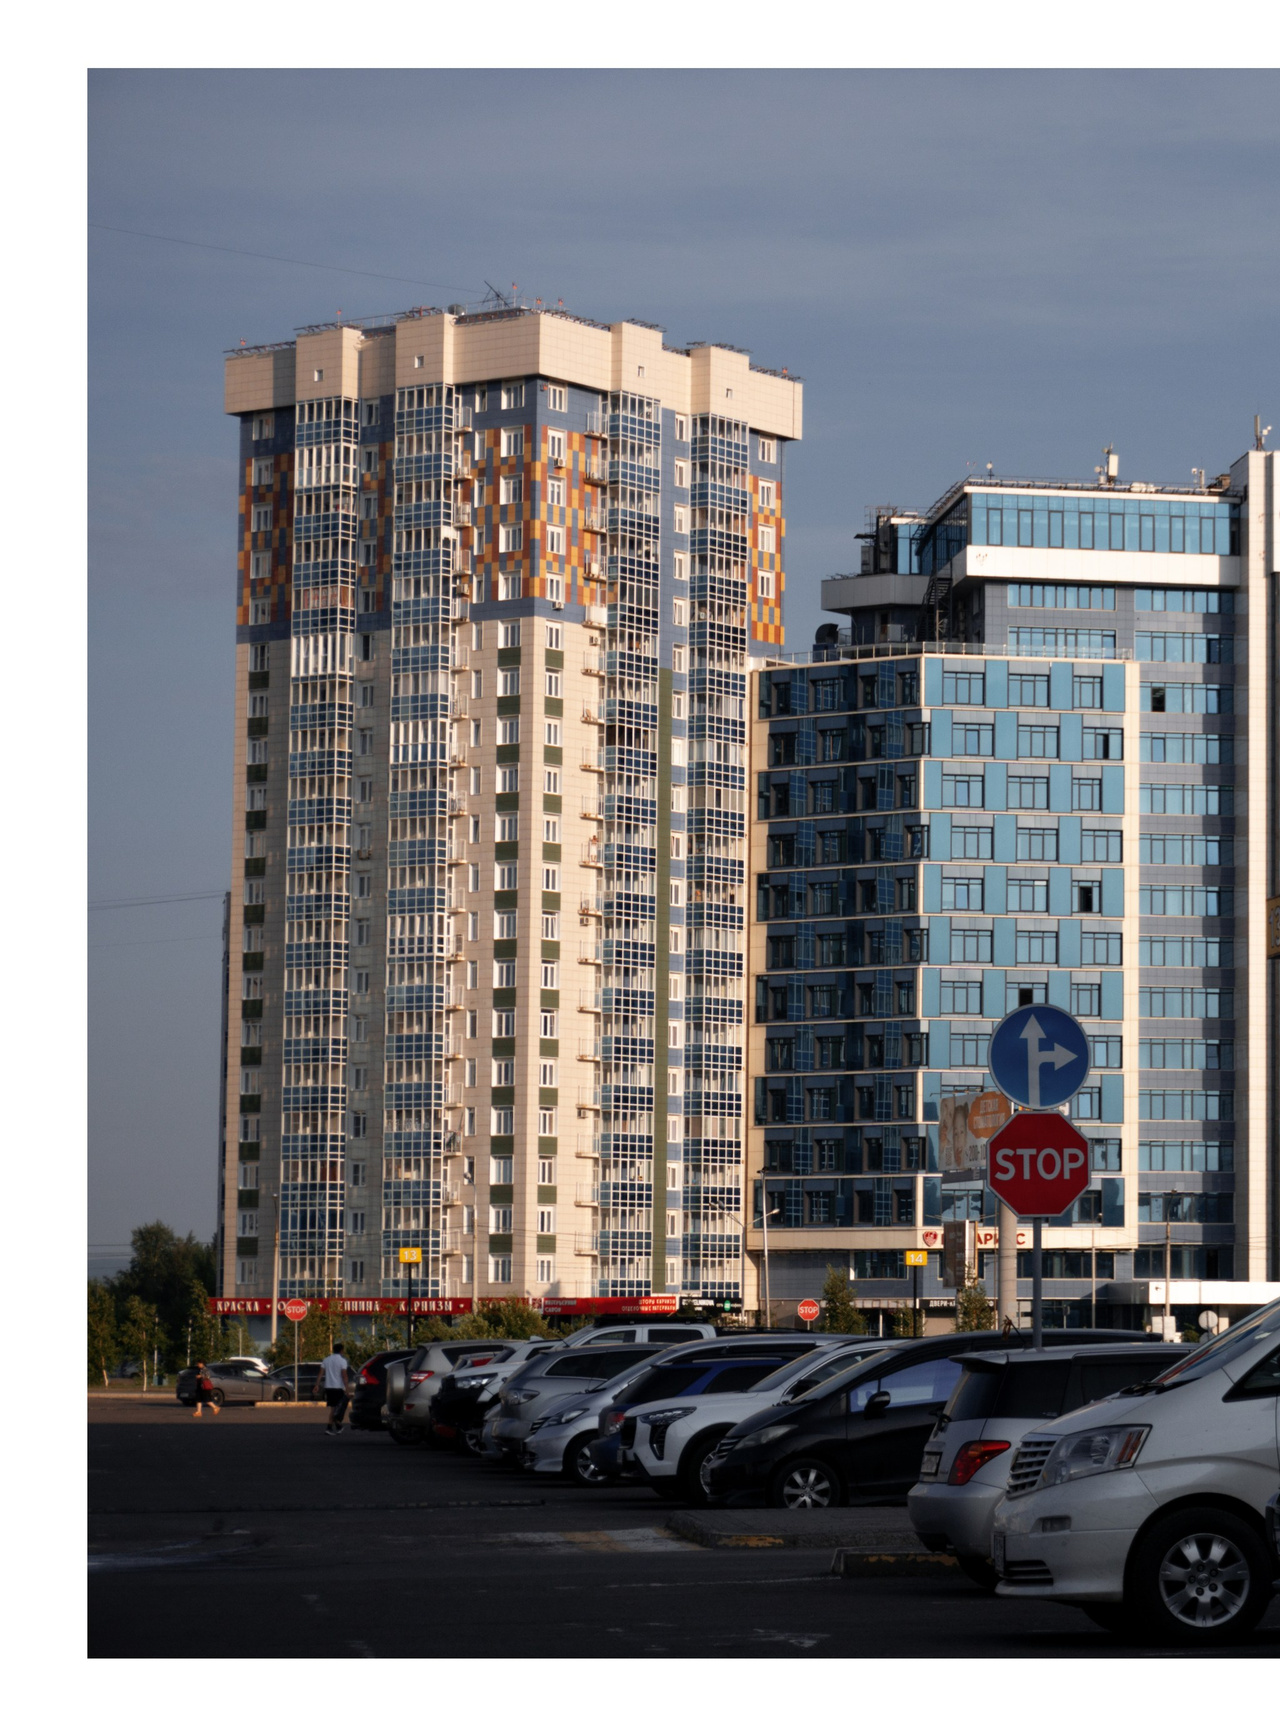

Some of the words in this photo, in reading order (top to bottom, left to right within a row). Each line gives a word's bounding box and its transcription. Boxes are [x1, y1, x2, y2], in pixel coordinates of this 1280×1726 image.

[994, 1148, 1085, 1181] STOP
[404, 1250, 417, 1260] 13
[909, 1253, 923, 1263] 14
[216, 1301, 259, 1311] КРАСКА
[399, 1301, 452, 1311] КРНИЗЫ
[286, 1305, 306, 1314] STOP
[799, 1306, 819, 1314] STOP
